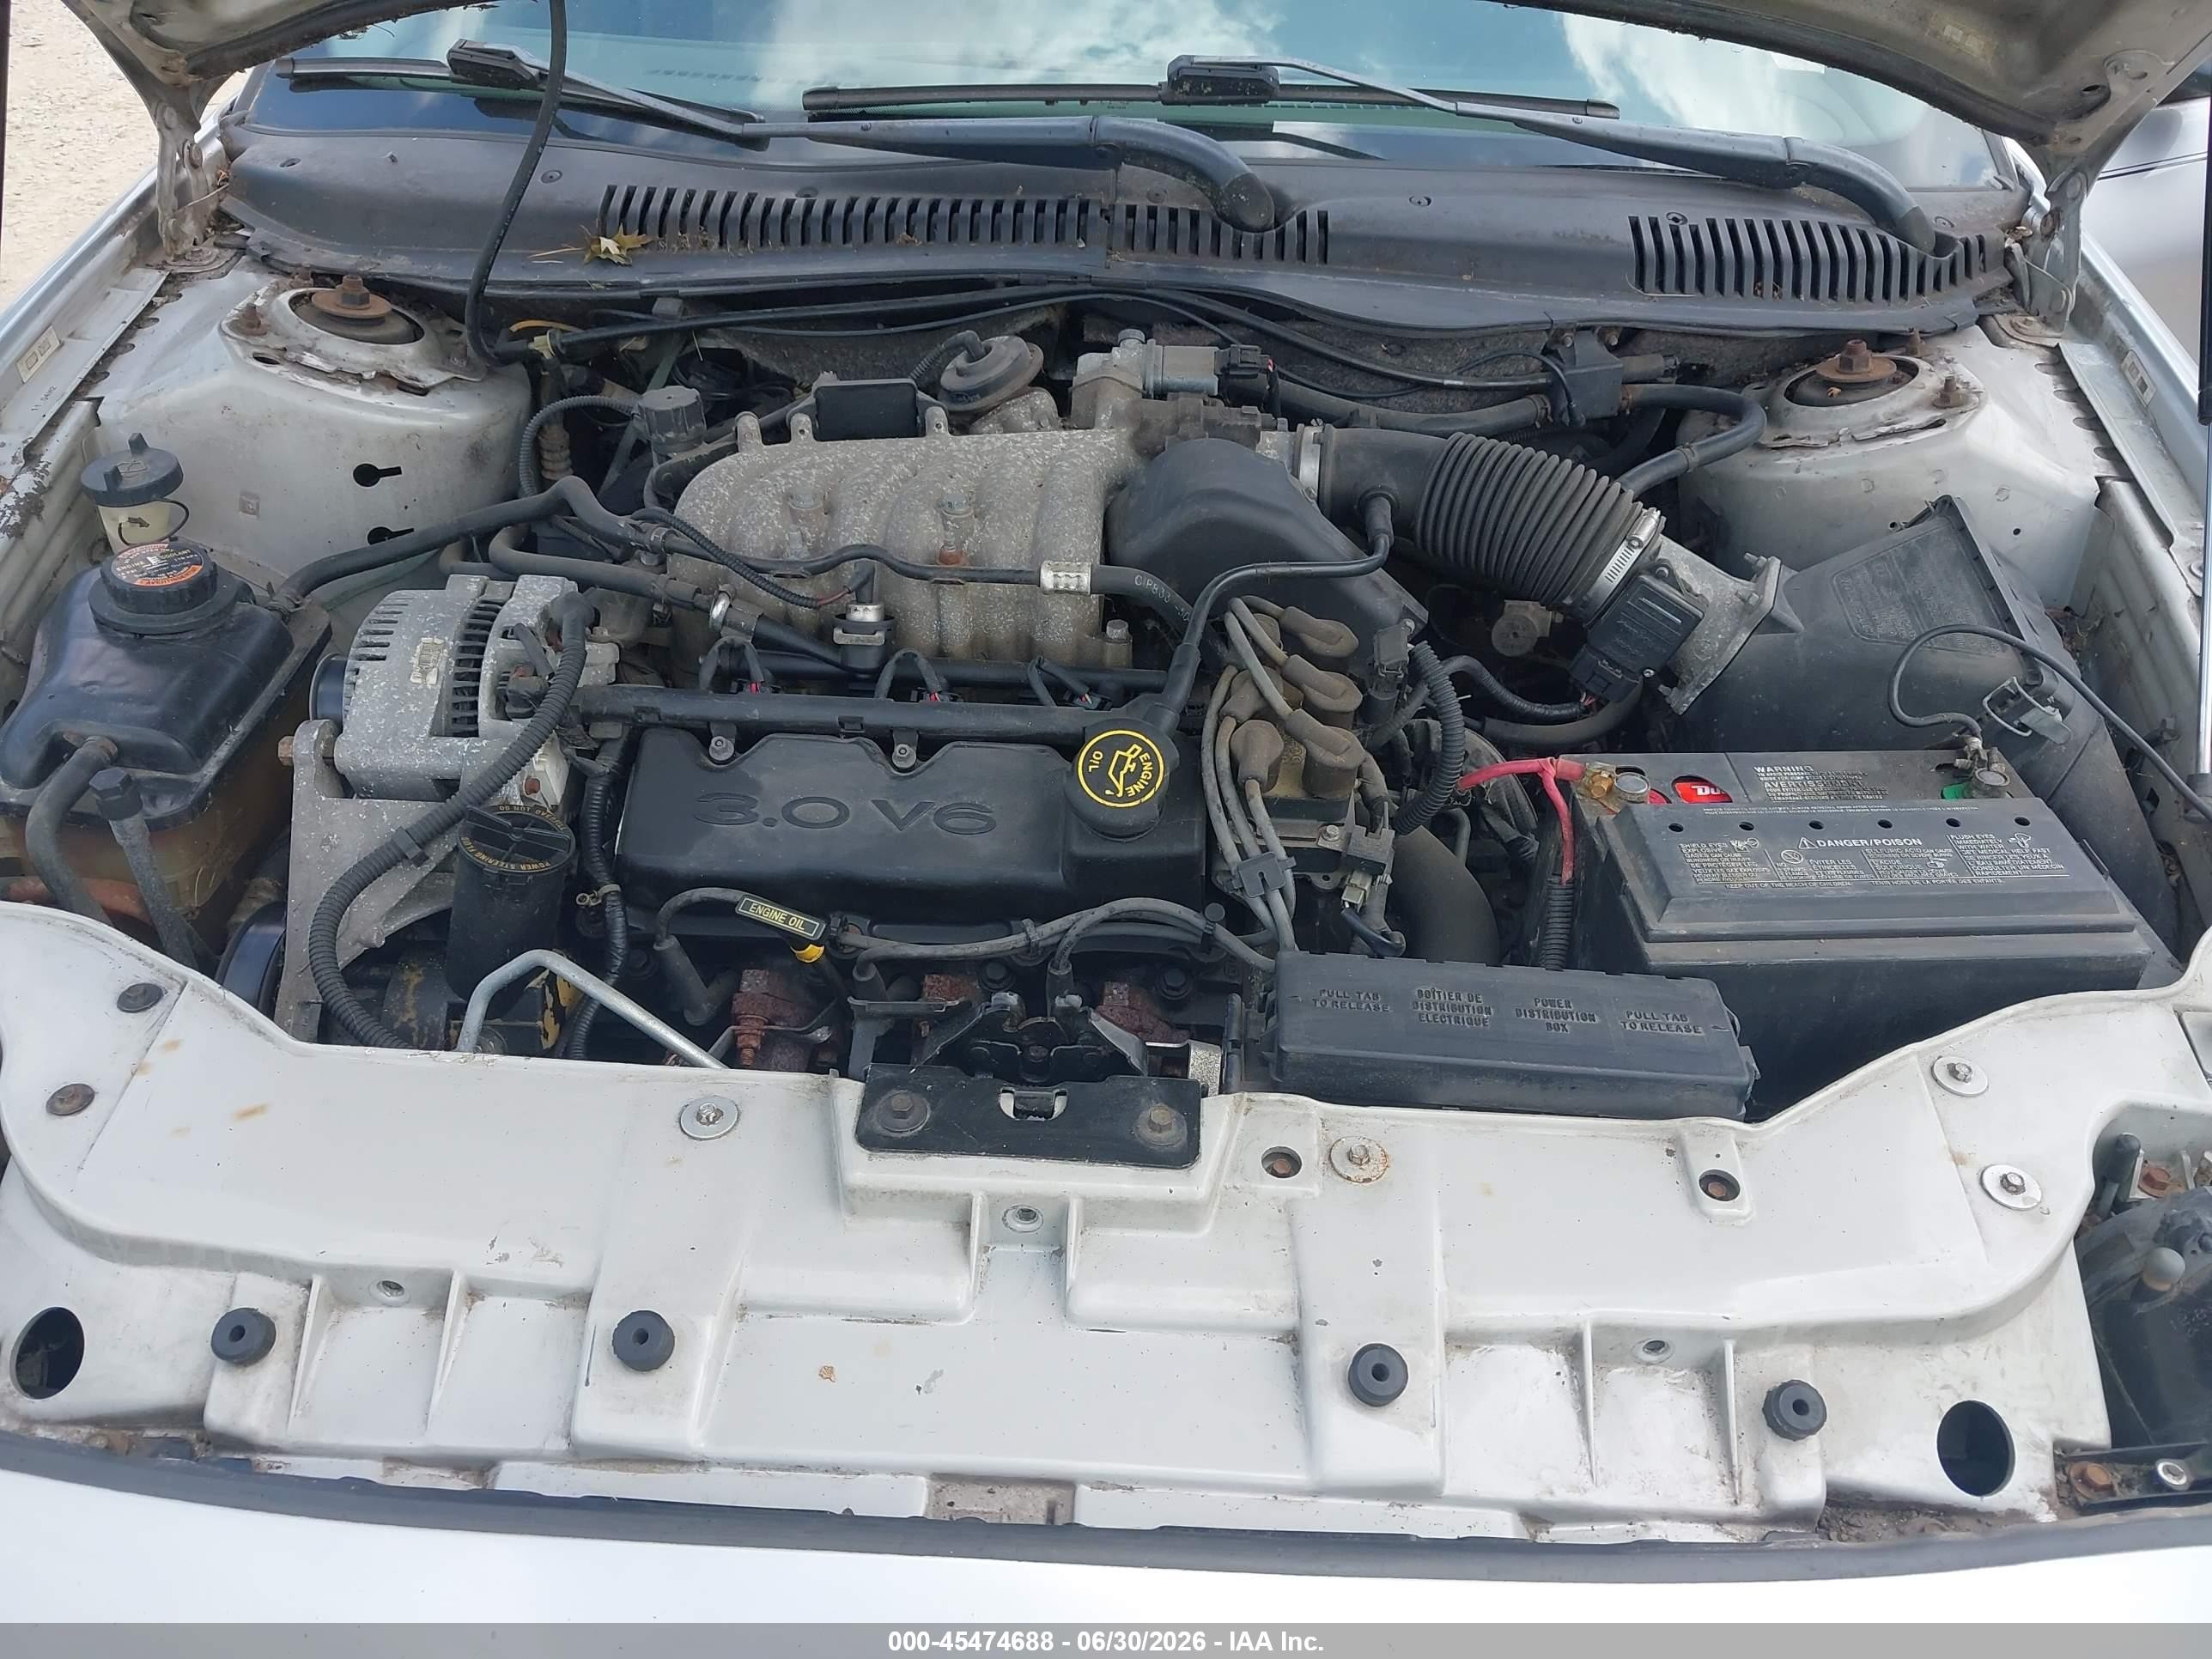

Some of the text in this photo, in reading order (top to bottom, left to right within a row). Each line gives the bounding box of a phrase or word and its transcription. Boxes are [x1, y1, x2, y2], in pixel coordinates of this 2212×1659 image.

[1088, 750, 1103, 772] OIL
[1125, 752, 1152, 797] ENGINE
[694, 792, 997, 835] 3.0 V6
[1816, 838, 1923, 847] DANGER/POISON
[475, 852, 516, 870] STEERING
[520, 861, 551, 870] POWER
[748, 902, 805, 931] ENGINE OIL
[1356, 991, 1380, 1001] TAB
[1467, 993, 1483, 1004] DE
[1534, 997, 1572, 1009] POWER
[1312, 998, 1390, 1012] TO RELEASE
[1413, 1000, 1493, 1016] DISTRIBUTION
[1515, 1008, 1596, 1023] DISTRIBUTION
[1626, 1010, 1689, 1022] PULL TAB
[1546, 1022, 1569, 1032] BOX
[1620, 1020, 1703, 1034] TO RELEASE
